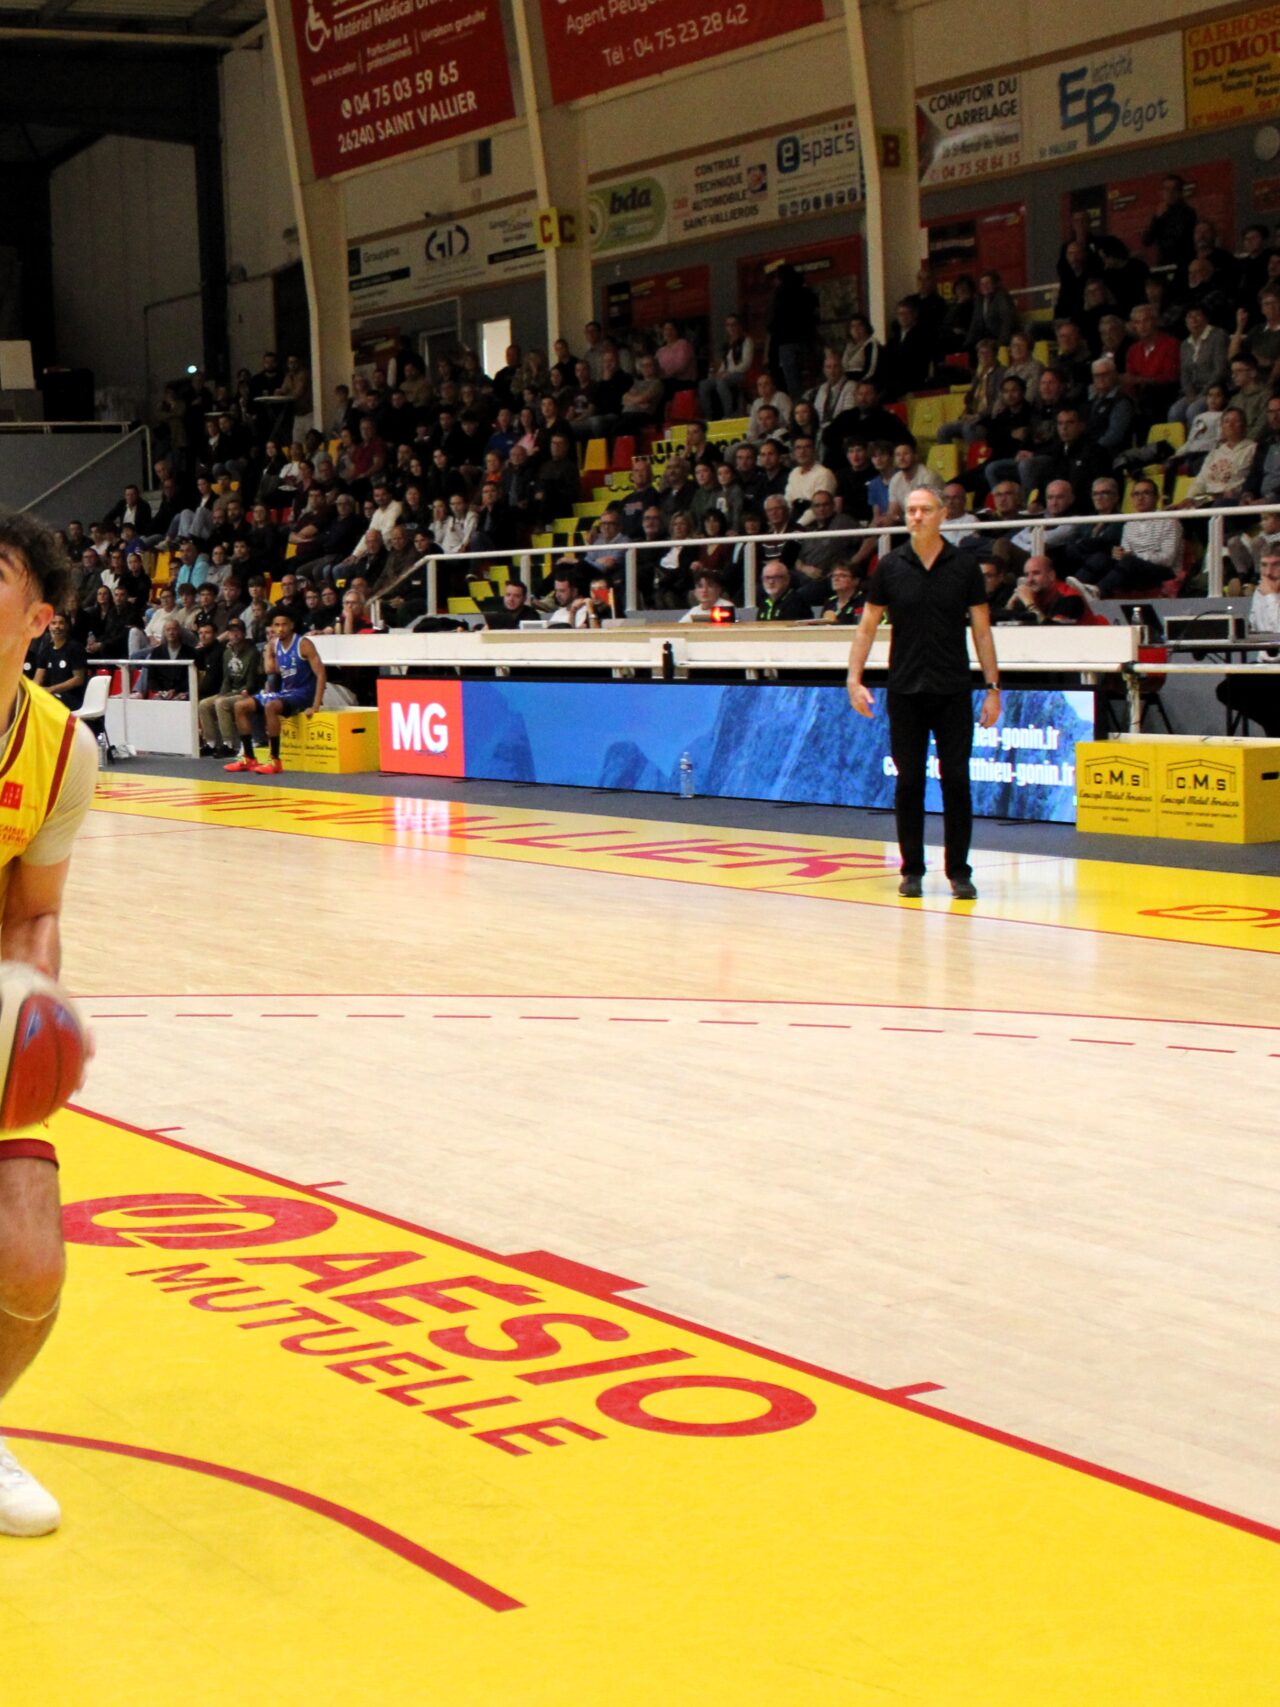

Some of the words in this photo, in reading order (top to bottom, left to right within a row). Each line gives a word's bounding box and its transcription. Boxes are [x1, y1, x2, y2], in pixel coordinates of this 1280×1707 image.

[566, 5, 607, 35] Agent
[633, 36, 654, 58] 04
[655, 29, 676, 51] 75
[677, 20, 700, 43] 23
[701, 13, 724, 37] 28
[725, 3, 749, 26] 42
[352, 91, 371, 116] 04
[372, 84, 391, 109] 75
[392, 76, 413, 102] 03
[415, 68, 434, 94] 59
[438, 60, 459, 86] 65
[928, 82, 995, 114] COMPTOIR
[997, 76, 1018, 98] DU
[337, 124, 376, 154] 26240
[376, 109, 416, 141] SAINT
[416, 90, 478, 127] VALLIER
[945, 98, 1018, 131] CARRELAGE
[882, 134, 901, 168] B
[609, 185, 652, 214] bda
[694, 172, 743, 194] TECHNIQUE
[691, 188, 748, 212] AUTOMOBILE
[539, 214, 554, 244] C
[559, 214, 576, 244] C
[682, 204, 759, 231] SAINT-VALLIEROIS
[390, 701, 450, 754] MG
[126, 1261, 609, 1458] MUTUELLE
